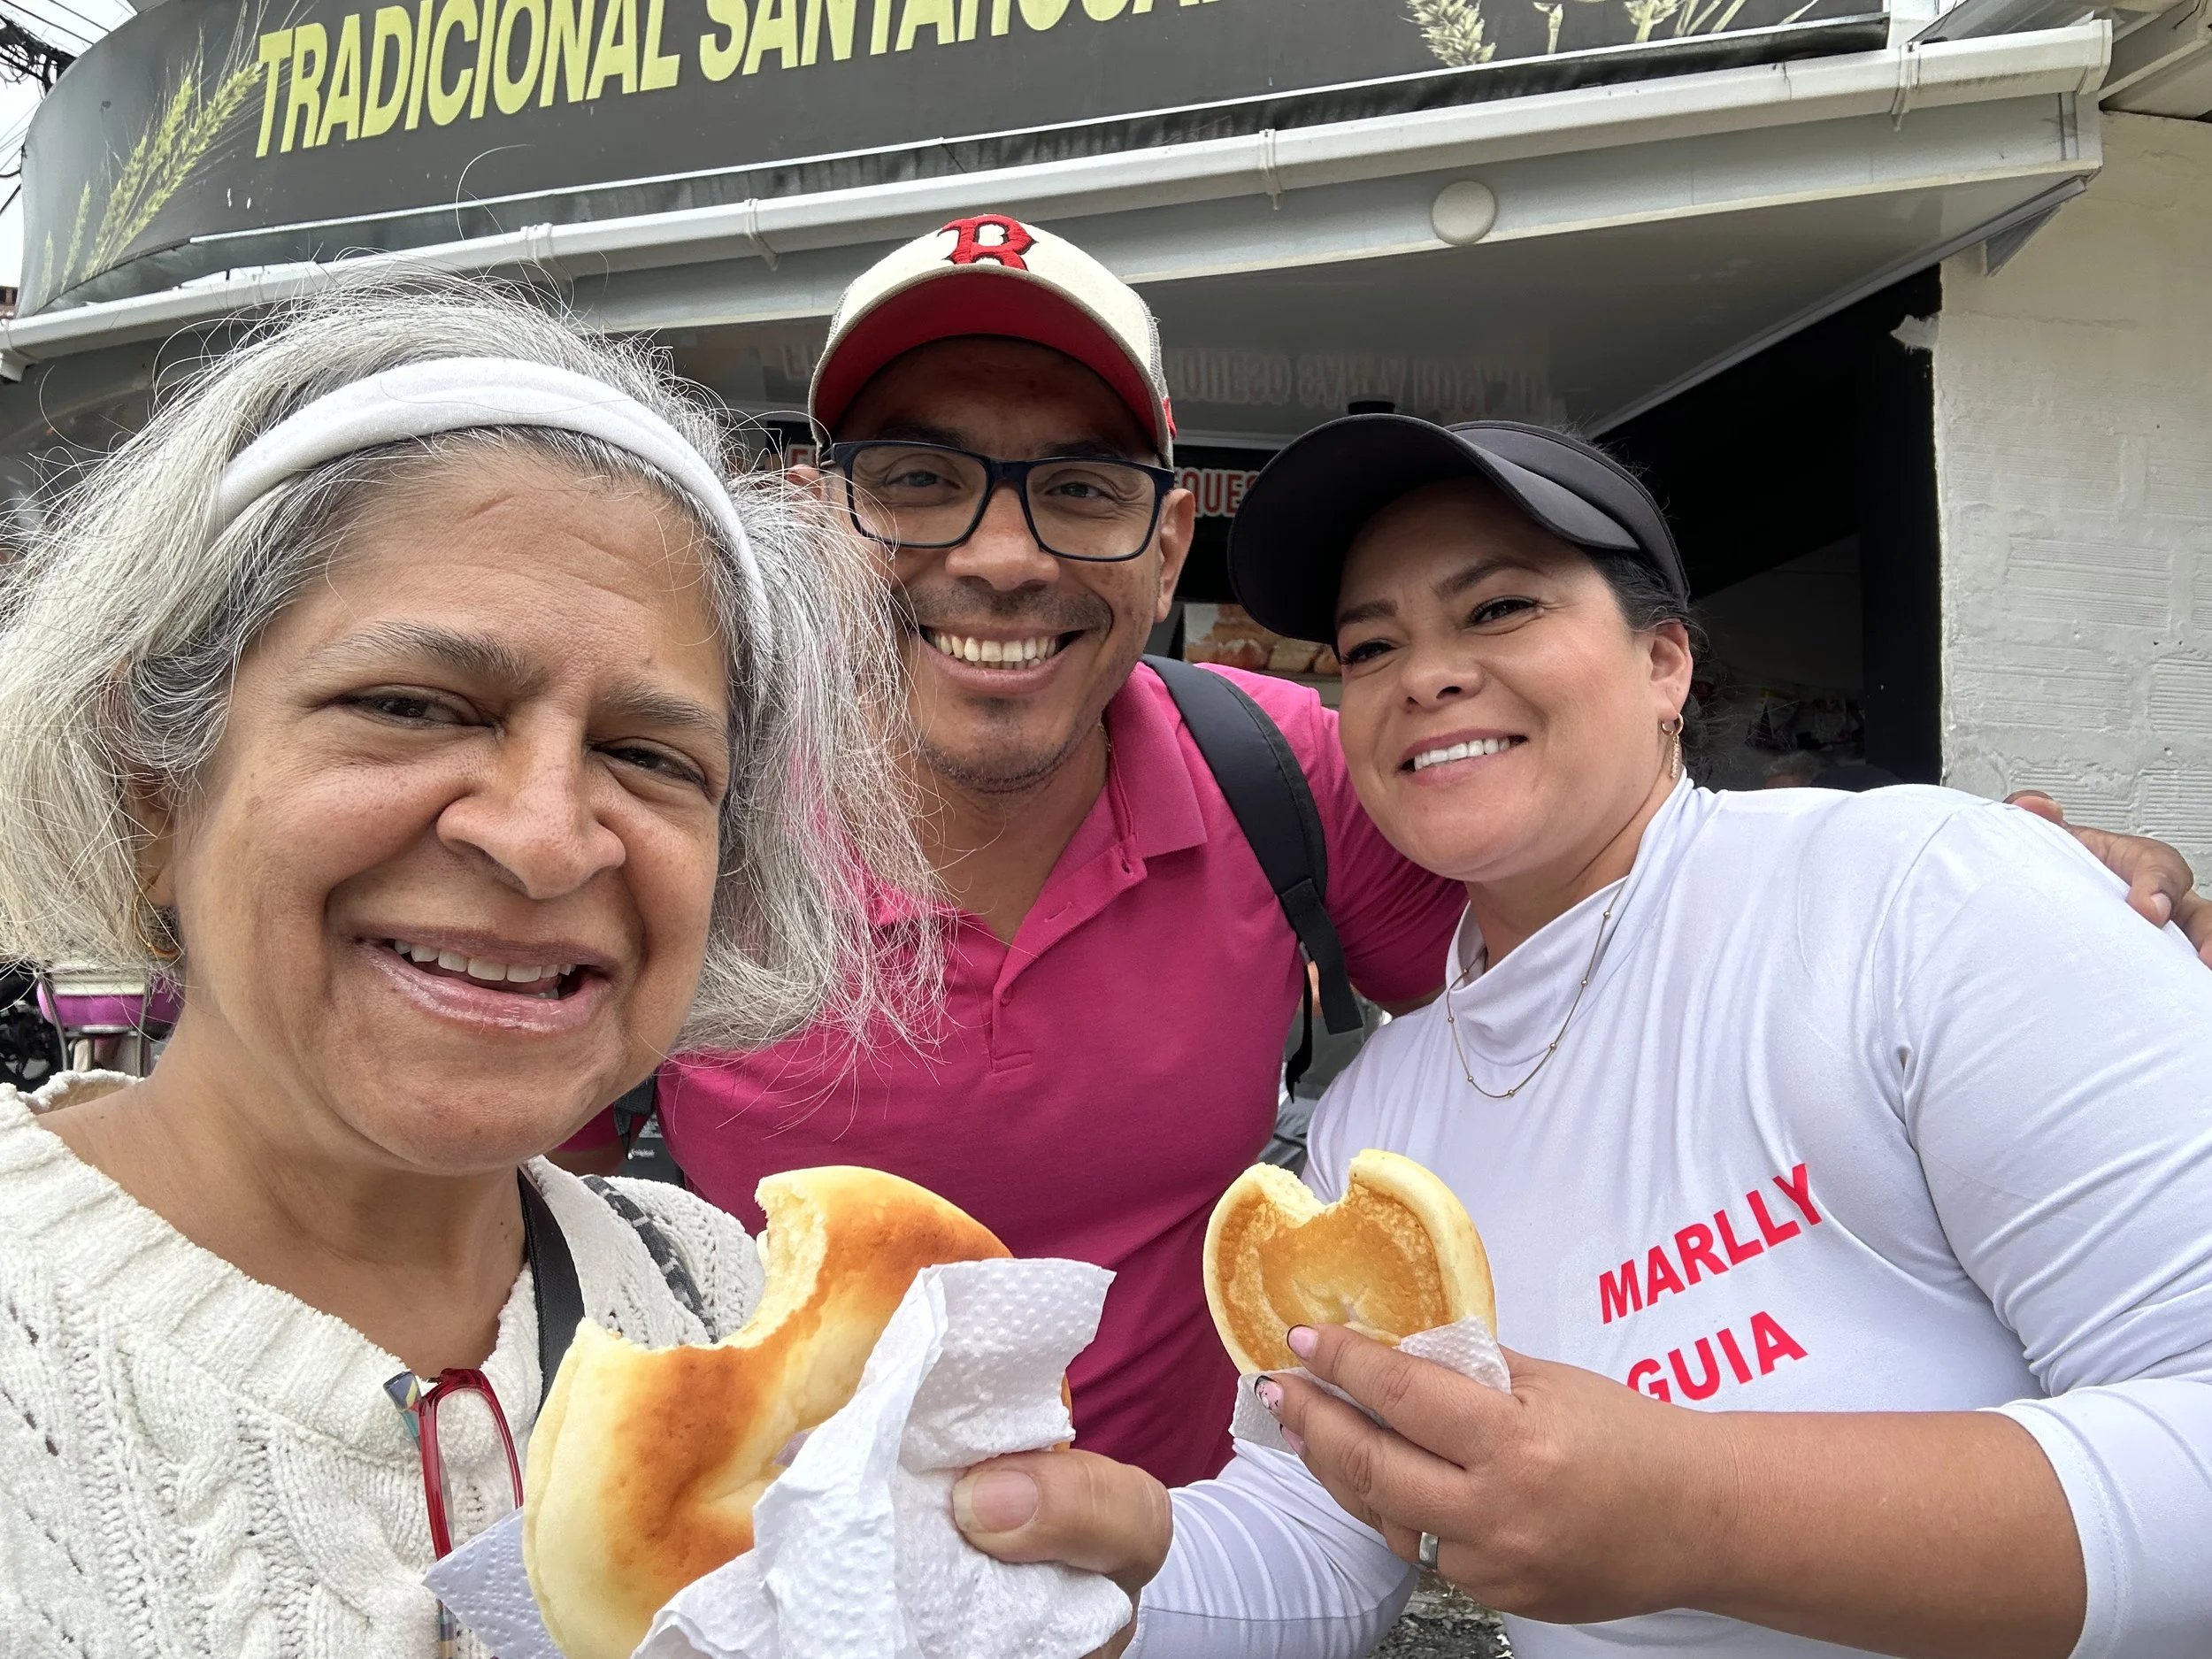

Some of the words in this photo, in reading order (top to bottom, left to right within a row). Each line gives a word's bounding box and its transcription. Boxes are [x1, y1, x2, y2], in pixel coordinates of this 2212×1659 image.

[255, 0, 680, 157] TRADICIONAL
[1599, 1163, 1823, 1325] MARLLY
[1627, 1311, 1809, 1403] GUIA
